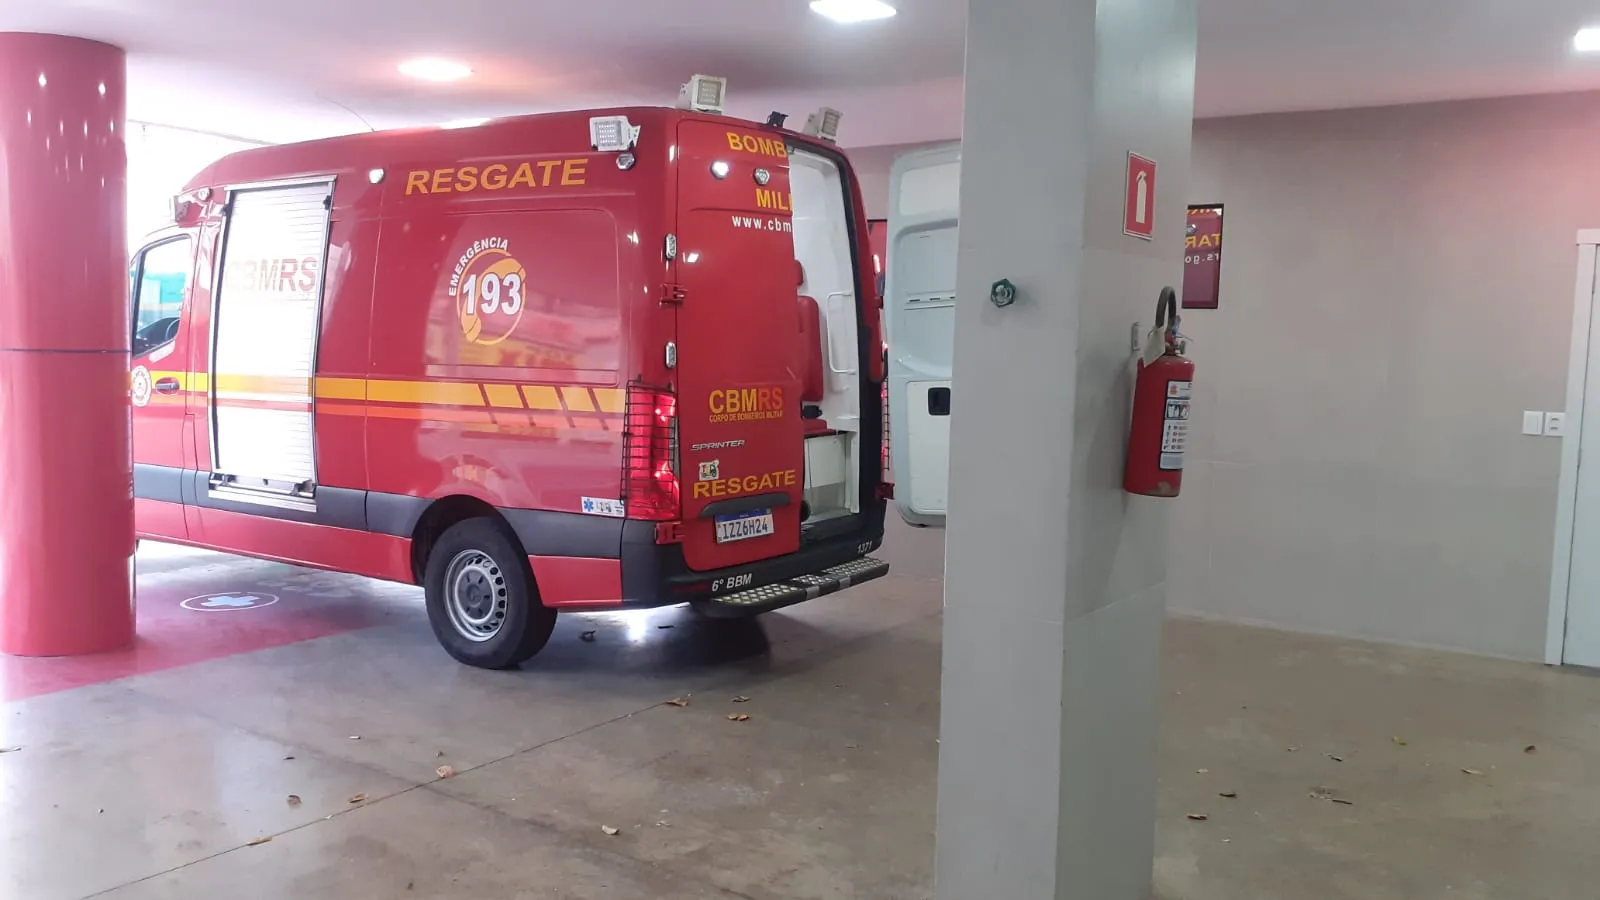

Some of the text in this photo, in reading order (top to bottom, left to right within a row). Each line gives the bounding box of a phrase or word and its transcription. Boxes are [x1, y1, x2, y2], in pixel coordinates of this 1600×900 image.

[726, 132, 787, 157] BOMB
[405, 158, 588, 195] RESGATE
[732, 216, 791, 232] www.cbm
[449, 237, 509, 296] EMERGÊNCIA
[463, 272, 522, 315] 193
[709, 387, 783, 413] CBMRS
[691, 440, 745, 451] SPRINTER
[693, 469, 796, 499] RESGATE
[858, 540, 872, 554] 1371
[727, 573, 752, 589] BBM
